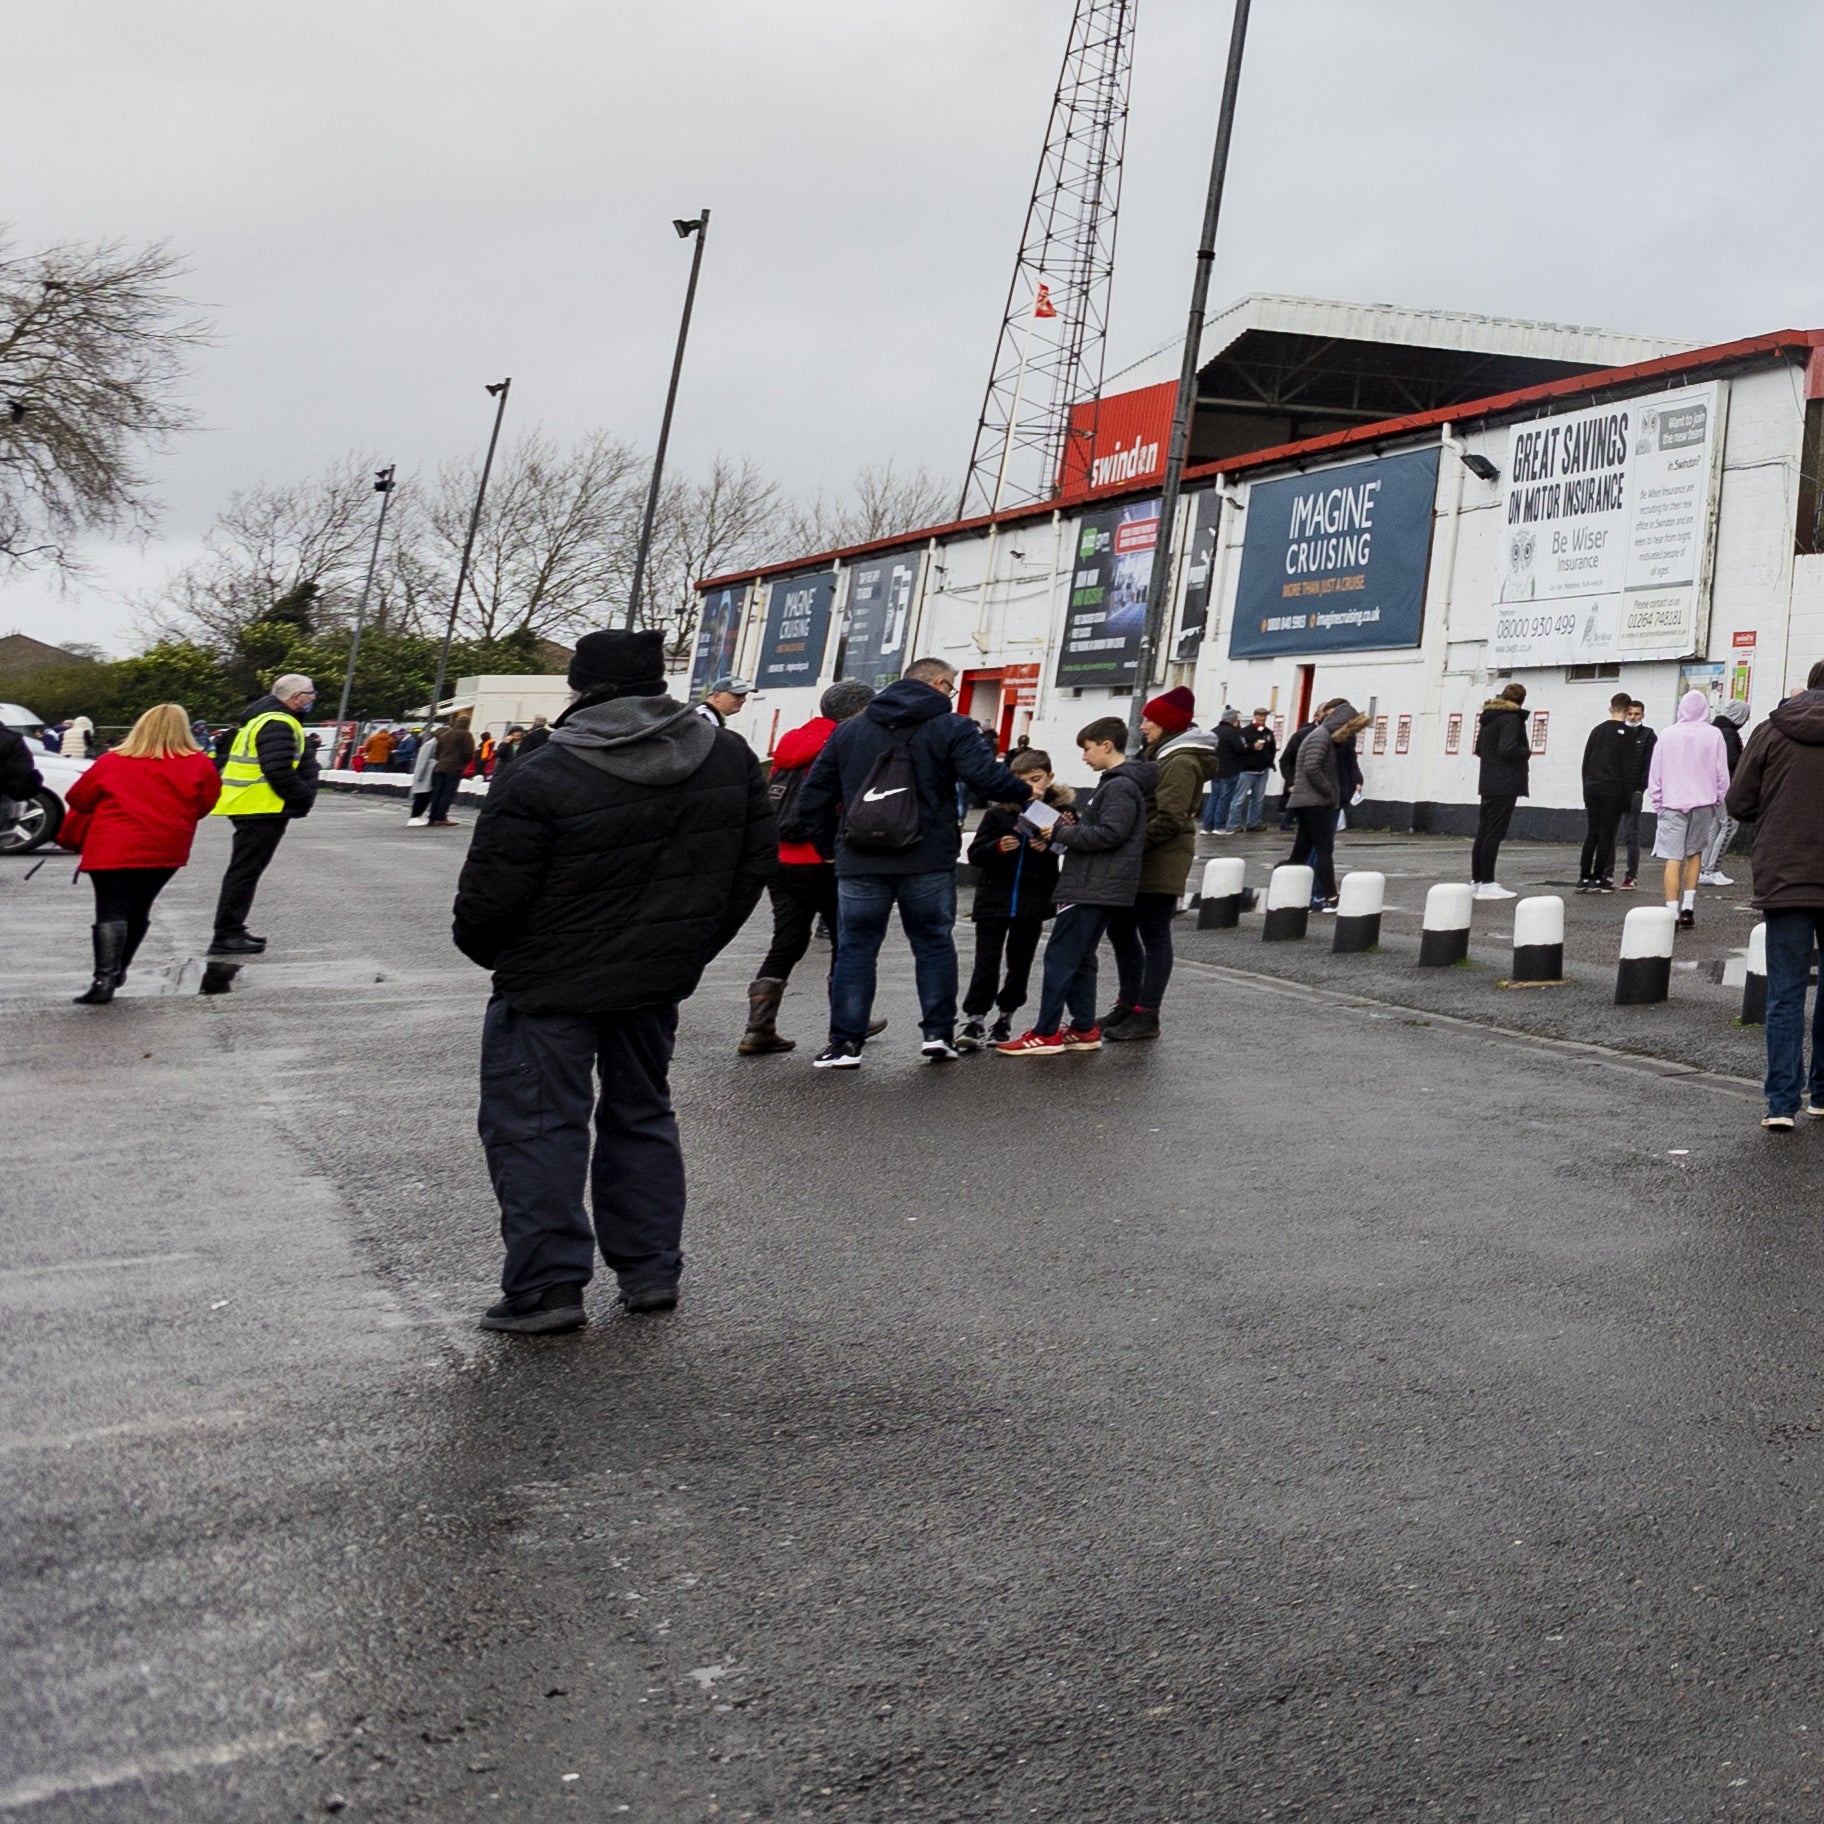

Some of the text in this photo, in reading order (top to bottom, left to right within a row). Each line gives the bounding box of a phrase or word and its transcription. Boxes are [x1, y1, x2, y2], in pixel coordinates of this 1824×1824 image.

[1513, 412, 1628, 483] GREAT SAVINGS
[1289, 481, 1377, 540] IMAGINE
[1508, 472, 1625, 525] ON MOTOR INSURANCE
[1285, 533, 1371, 575] CRUISING
[1552, 526, 1608, 554] Be Wiser
[1557, 555, 1599, 572] Insurance
[1282, 583, 1302, 598] MORE
[1302, 580, 1320, 595] THAN
[1496, 614, 1576, 639] 08000 930 499
[1628, 610, 1682, 629] 01264 748181
